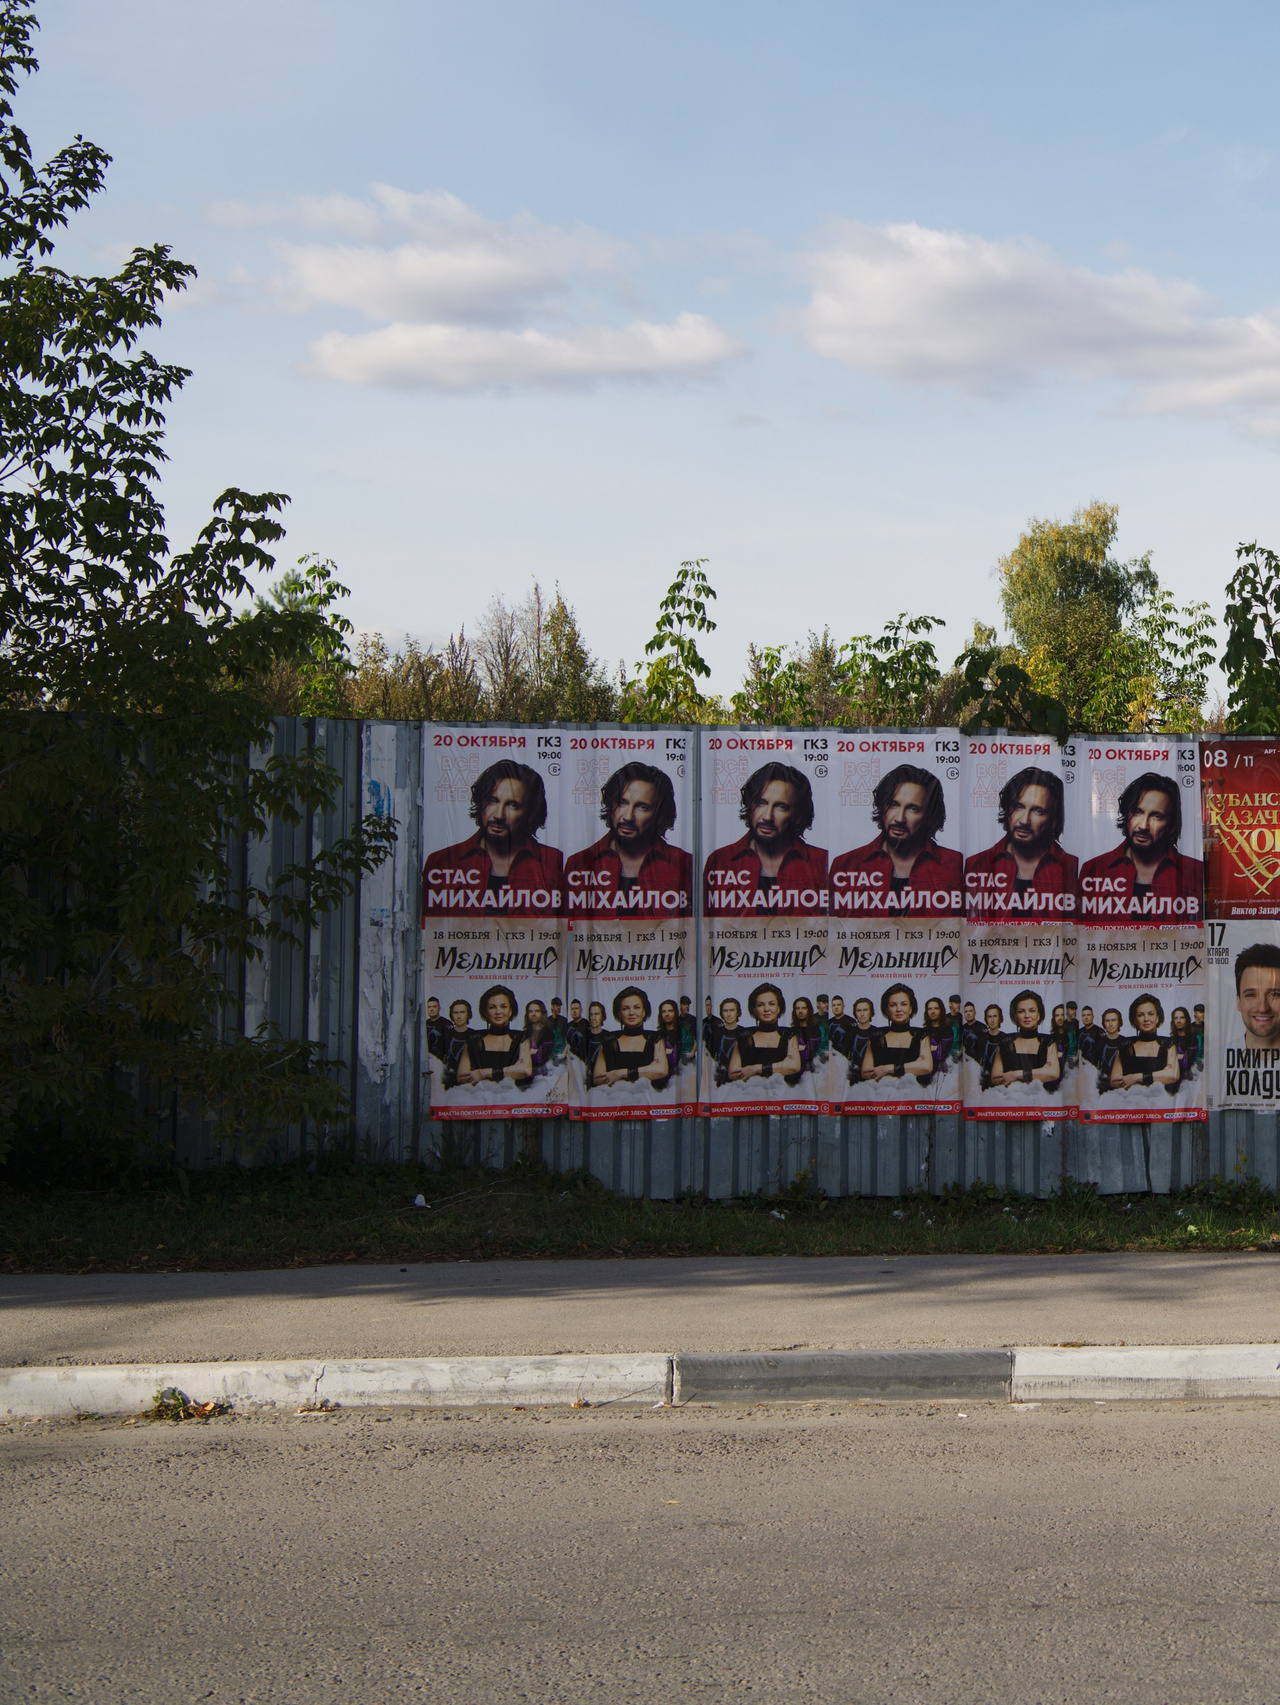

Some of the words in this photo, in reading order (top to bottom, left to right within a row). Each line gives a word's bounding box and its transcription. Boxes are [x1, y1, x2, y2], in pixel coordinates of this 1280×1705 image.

[433, 735, 453, 746] 20
[457, 736, 526, 748] ОКТЯБРЯ
[537, 736, 562, 748] ГКЗ
[569, 738, 588, 750] 20
[591, 738, 655, 750] ОКТЯБРЯ
[708, 738, 722, 750] 20
[726, 739, 793, 750] ОКТЯБРЯ
[803, 739, 828, 750] ГКЗ
[836, 741, 855, 753] 20
[859, 741, 925, 753] ОКТЯБРЯ
[935, 741, 960, 752] ГКЗ
[969, 743, 987, 754] 20
[991, 743, 1051, 756] ОКТЯБРЯ
[1088, 748, 1102, 760] 20
[1105, 749, 1169, 761] ОКТЯБРЯ
[804, 753, 829, 761] 19:00
[936, 756, 960, 764] 19:00
[1204, 750, 1228, 768] 08
[428, 869, 481, 885] СТАС
[567, 870, 611, 886] СТАС
[708, 870, 751, 885] СТАС
[833, 871, 883, 887] СТАС
[965, 872, 1008, 888] СТАС
[1082, 877, 1127, 892] СТАС
[428, 885, 562, 908] МИХАЙЛОВ
[569, 886, 688, 909] МИХАЙЛОВ
[708, 886, 829, 908] МИХАЙЛОВ
[834, 887, 962, 909] МИХАЙЛОВ
[1082, 893, 1199, 915] МИХАЙЛОВ
[1231, 906, 1257, 915] Виктор
[433, 931, 444, 940] 18
[448, 931, 491, 940] НОЯБРЯ
[505, 931, 525, 940] ГКЗ
[574, 934, 584, 942] 18
[636, 932, 655, 941] ГКЗ
[717, 931, 758, 939] НОЯБРЯ
[772, 930, 791, 938] ГКЗ
[803, 930, 829, 938] 19:00
[836, 931, 846, 940] 18
[850, 931, 890, 940] НОЯБРЯ
[904, 931, 924, 939] ГКЗ
[936, 931, 960, 939] 19:00
[1208, 923, 1226, 947] 17
[967, 939, 977, 947] 18
[980, 938, 1019, 947] НОЯБРЯ
[1033, 938, 1051, 946] ГКЗ
[1087, 943, 1096, 951] 18
[1099, 943, 1137, 951] НОЯБРЯ
[1150, 942, 1168, 950] ГКЗ
[1180, 941, 1204, 950] 19:00
[1207, 948, 1229, 957] КТЯБРЯ
